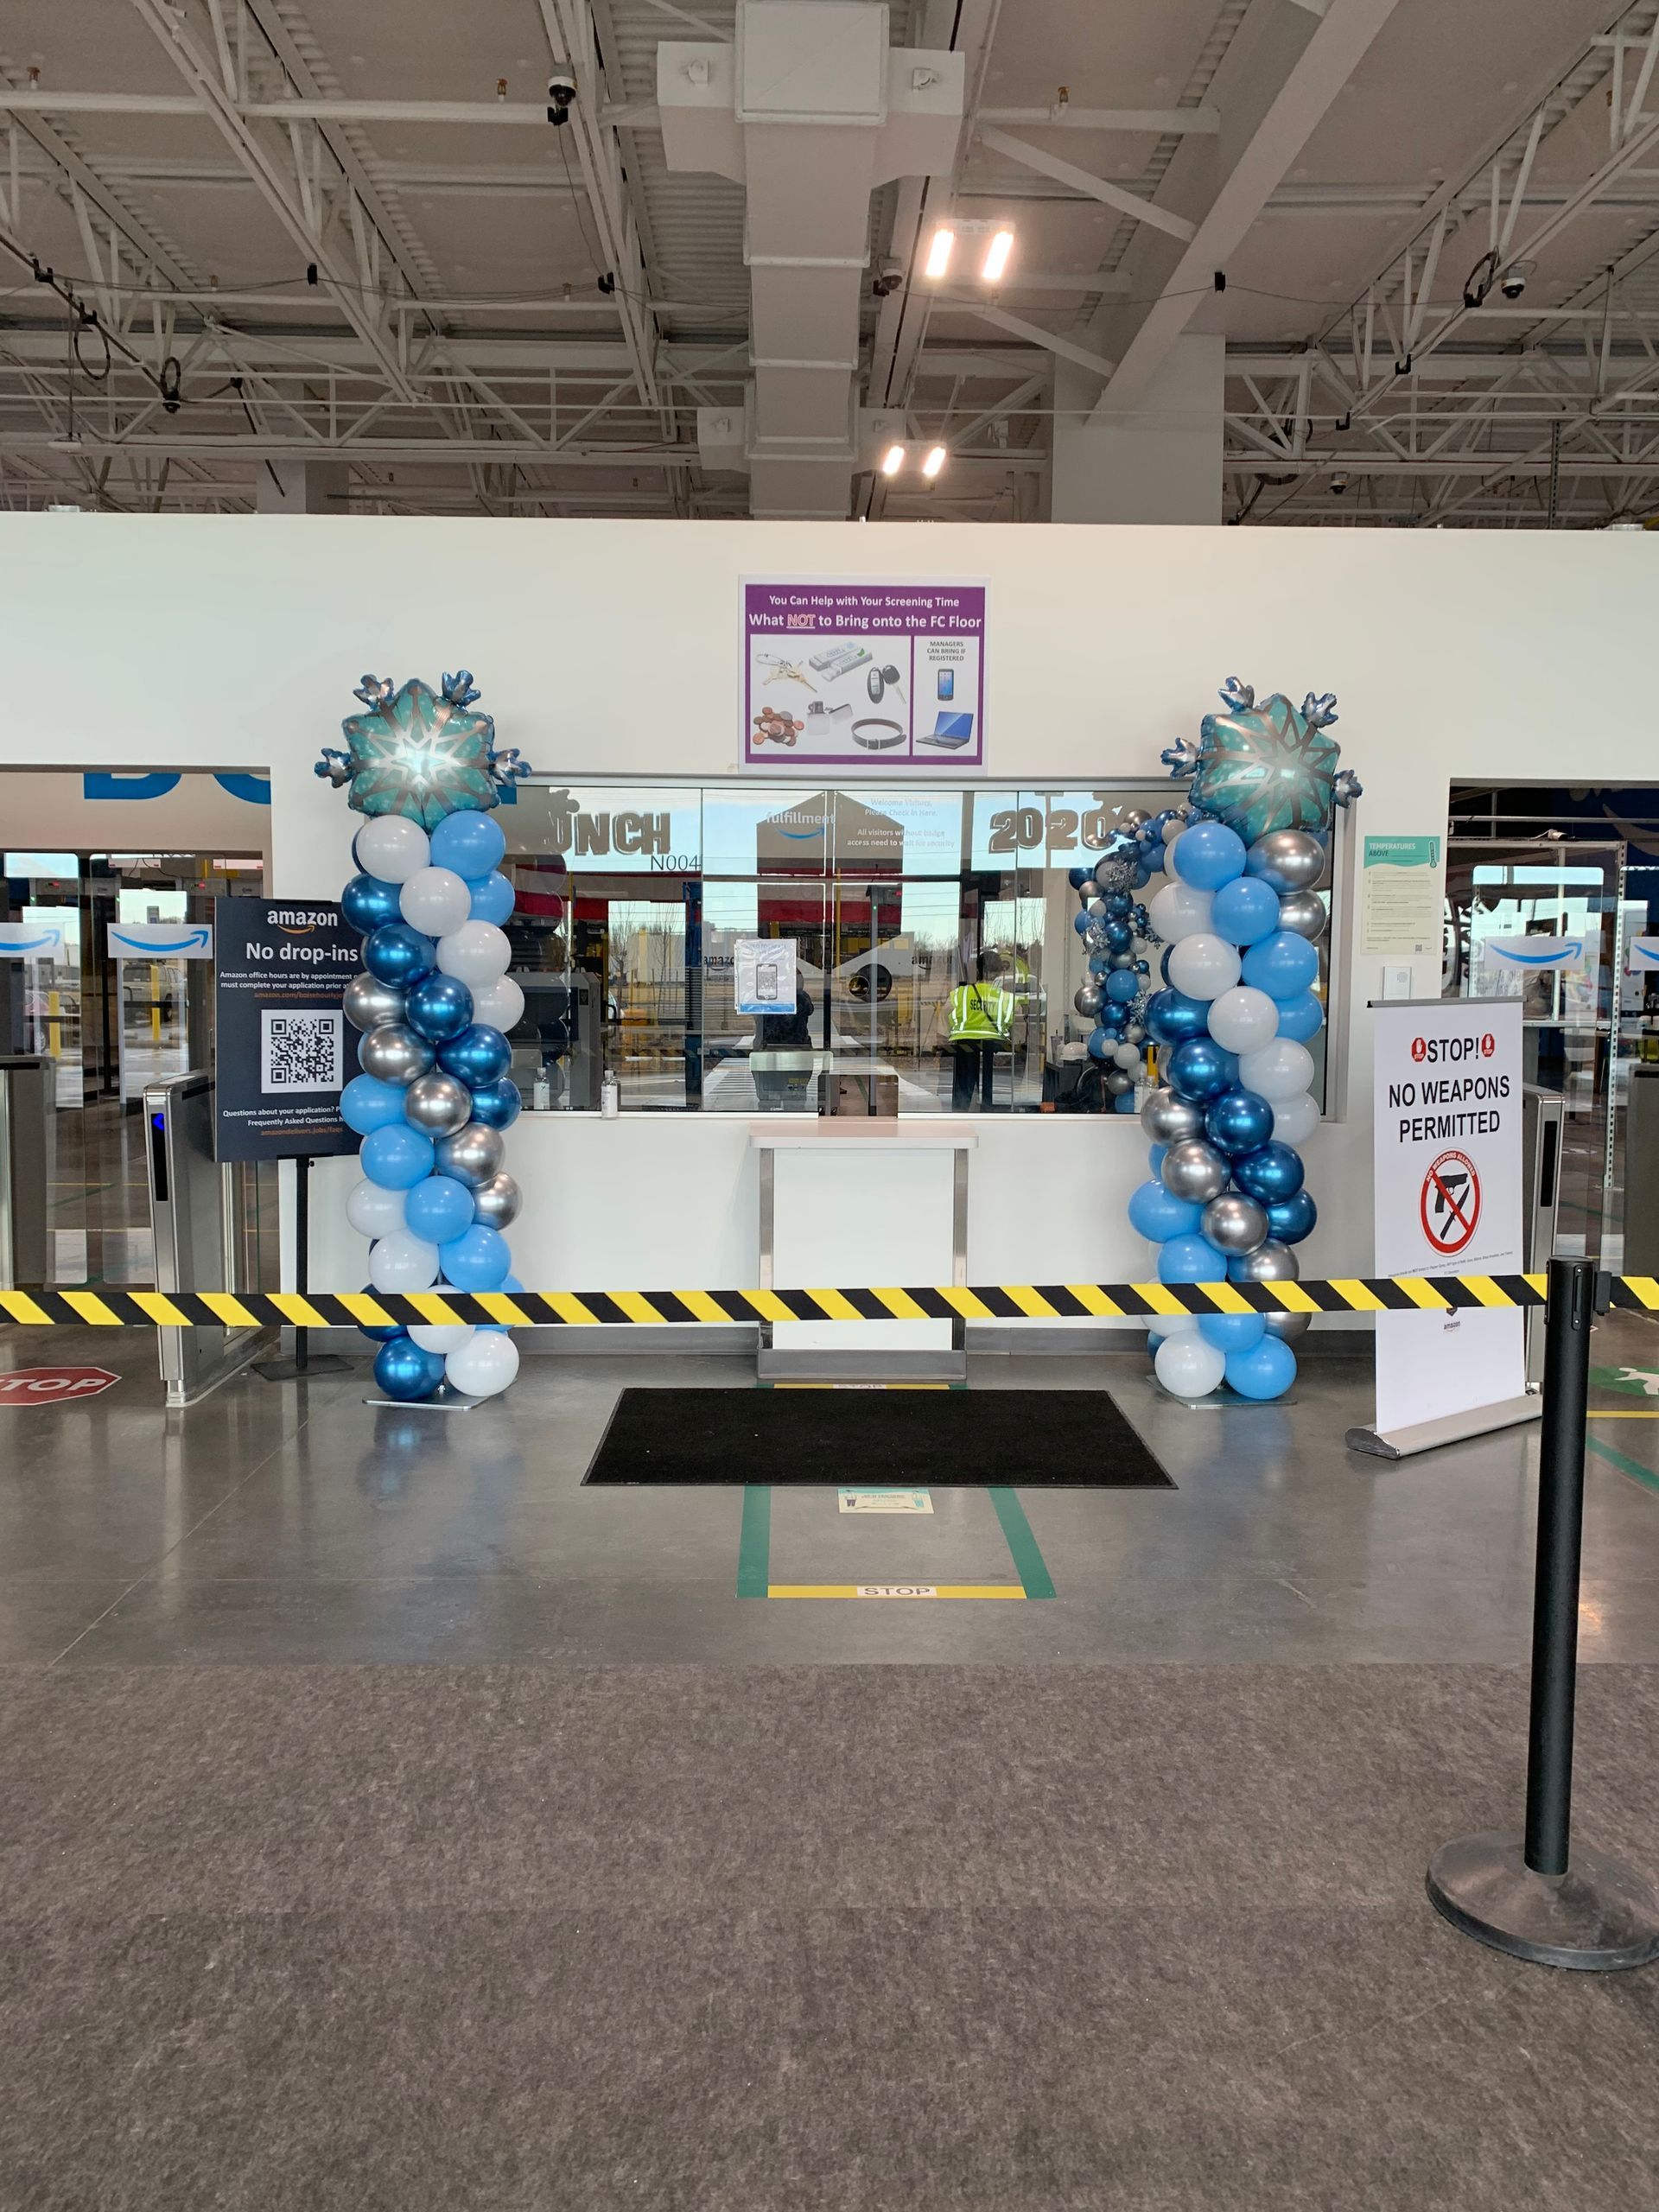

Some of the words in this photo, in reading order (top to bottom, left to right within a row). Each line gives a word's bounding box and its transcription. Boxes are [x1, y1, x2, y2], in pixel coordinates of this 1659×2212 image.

[769, 595, 787, 605] You
[790, 595, 808, 605] Can
[810, 595, 833, 607] Help
[836, 596, 858, 606] with
[861, 596, 882, 607] Your
[885, 596, 933, 608] Screening
[935, 597, 960, 607] Time
[748, 613, 784, 626] What
[786, 613, 816, 628] NOT
[818, 615, 832, 626] to
[836, 614, 869, 629] Bring
[872, 616, 902, 627] onto
[905, 615, 927, 627] the
[930, 616, 946, 627] FC
[949, 615, 982, 627] Floor
[766, 811, 836, 824] fulfillment
[895, 829, 922, 837] without
[988, 807, 1117, 854] 2020
[651, 855, 702, 871] N004
[267, 910, 338, 926] amazon
[246, 943, 274, 960] No
[279, 943, 359, 964] drop-ins
[301, 972, 309, 981] by
[311, 973, 353, 982] appointment
[239, 982, 270, 990] complete
[1427, 1038, 1479, 1063] STOP!
[1389, 1083, 1415, 1108] NO
[1421, 1076, 1510, 1105] WEAPONS
[296, 1106, 334, 1115] application?
[248, 1118, 283, 1127] Frequently
[1400, 1110, 1500, 1142] PERMITTED
[1426, 1170, 1433, 1182] NO
[1432, 1152, 1457, 1170] WEAPONS
[1457, 1154, 1476, 1177] ALLOWED
[0, 1378, 107, 1391] TOP
